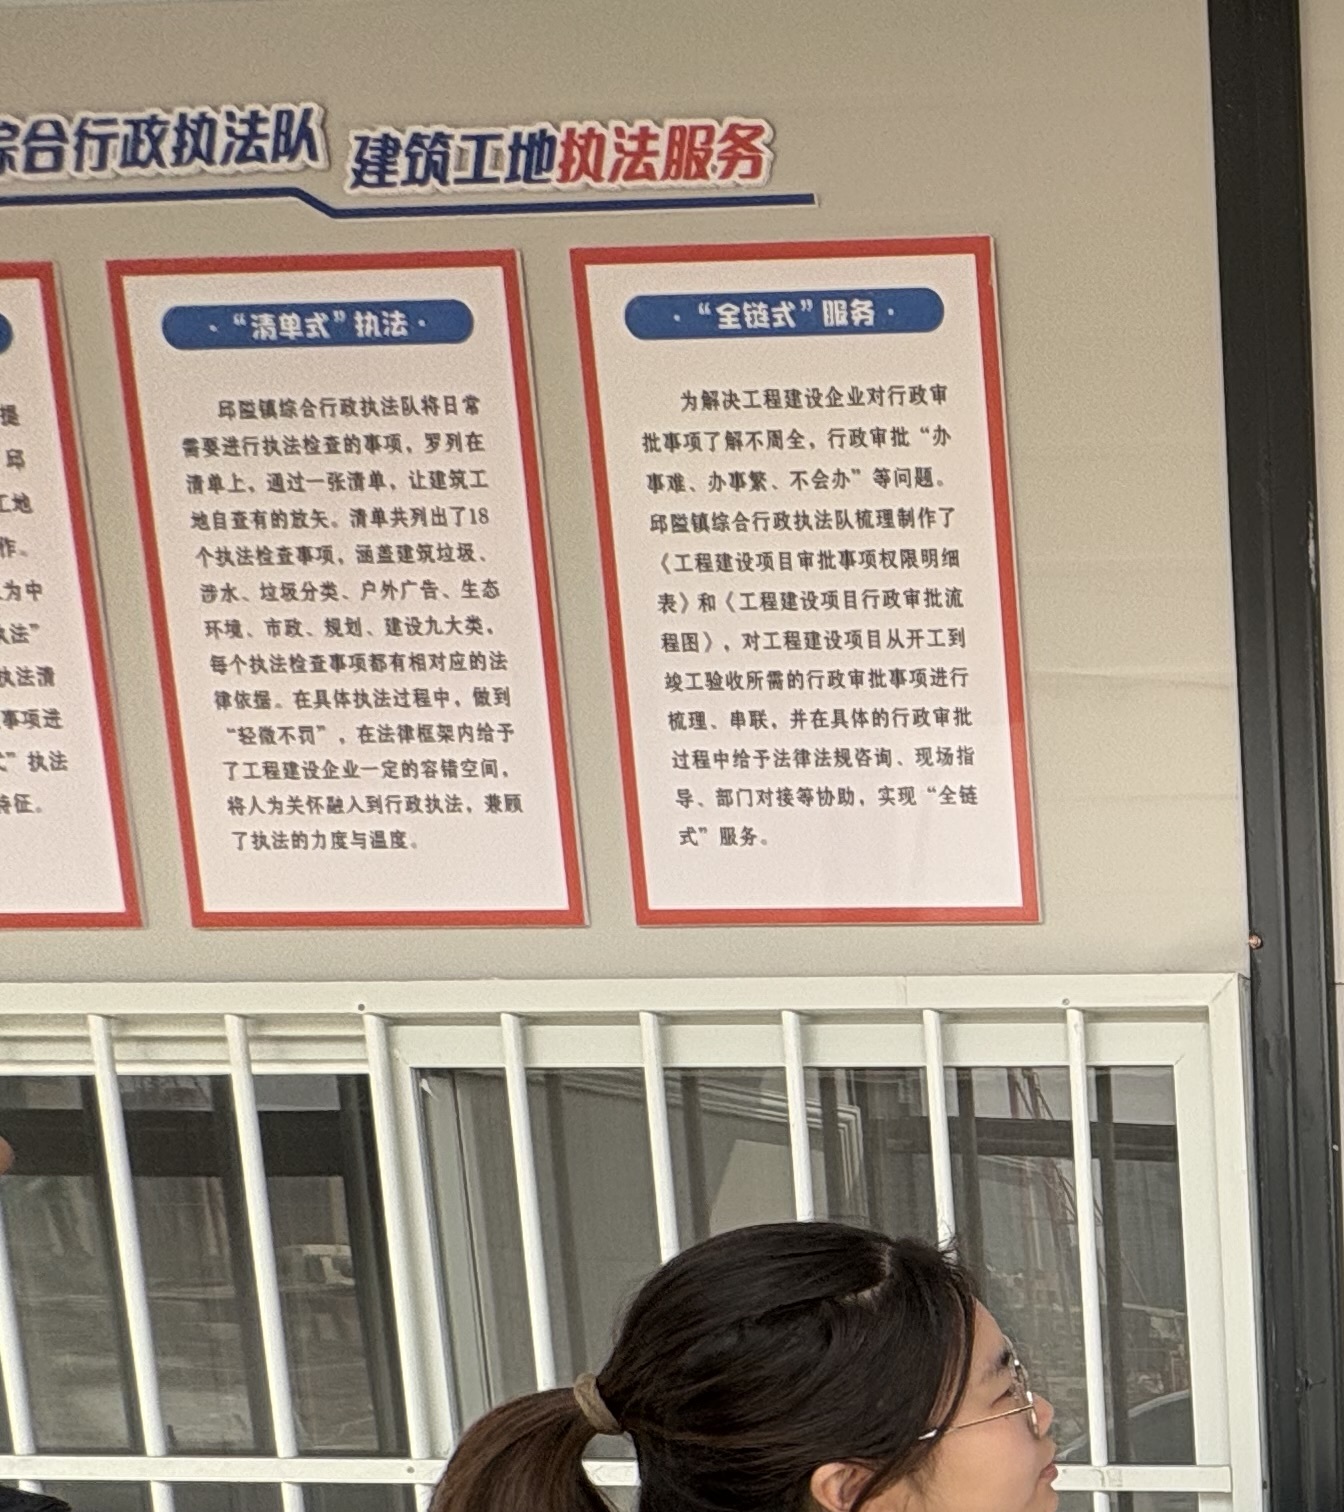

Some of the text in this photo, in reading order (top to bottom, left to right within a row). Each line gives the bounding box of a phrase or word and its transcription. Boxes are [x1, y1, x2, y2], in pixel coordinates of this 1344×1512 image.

[350, 122, 768, 189] 建筑工地执法服务
[218, 395, 481, 420] 邱隘镇综合行政执法队将日常
[680, 383, 948, 412] 为解决工程建设企业对行政审
[650, 506, 956, 534] 邱隘镇综合行政执法队梳理制作了
[660, 547, 960, 575] 《工程建设项目审批事项权限明细
[656, 586, 965, 615] 表》和《工程建设项目行政审批流
[210, 651, 508, 676] 每个执法检查事项都有相对应的法
[664, 666, 970, 693] 竣工验收所需的行政审批事项进行
[672, 745, 976, 771] 过程中给予法律法规咨询、现场指
[231, 829, 418, 852] 了执法的力度与温度。
